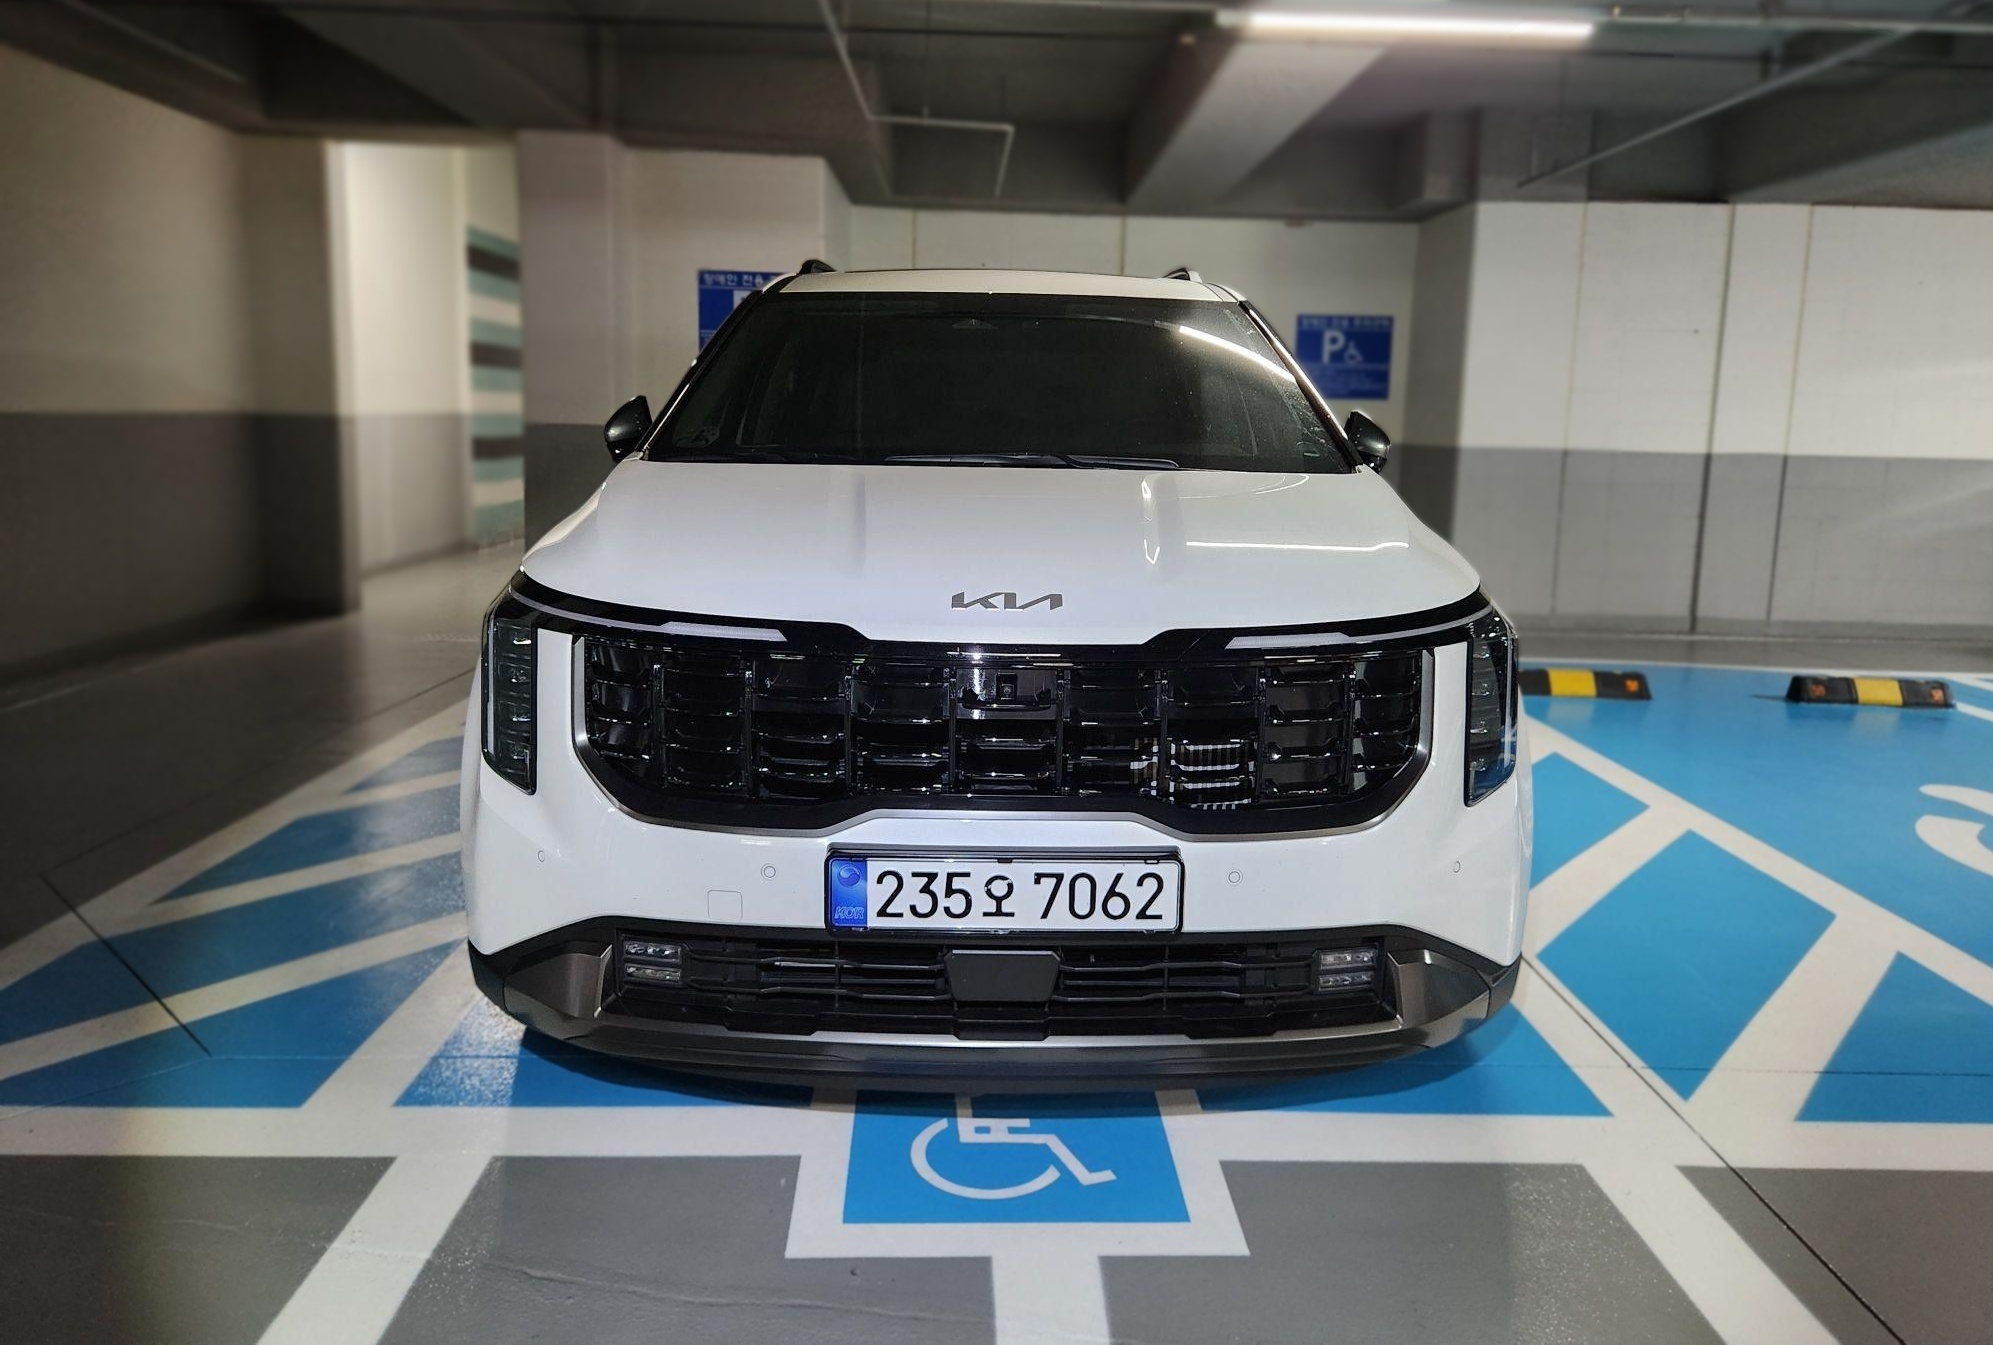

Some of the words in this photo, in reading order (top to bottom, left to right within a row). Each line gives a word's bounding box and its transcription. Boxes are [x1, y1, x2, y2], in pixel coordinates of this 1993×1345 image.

[1322, 330, 1345, 364] P
[951, 591, 1063, 610] KIA
[876, 870, 1015, 919] 235오
[1033, 872, 1164, 920] 7062
[834, 906, 865, 919] KOR
